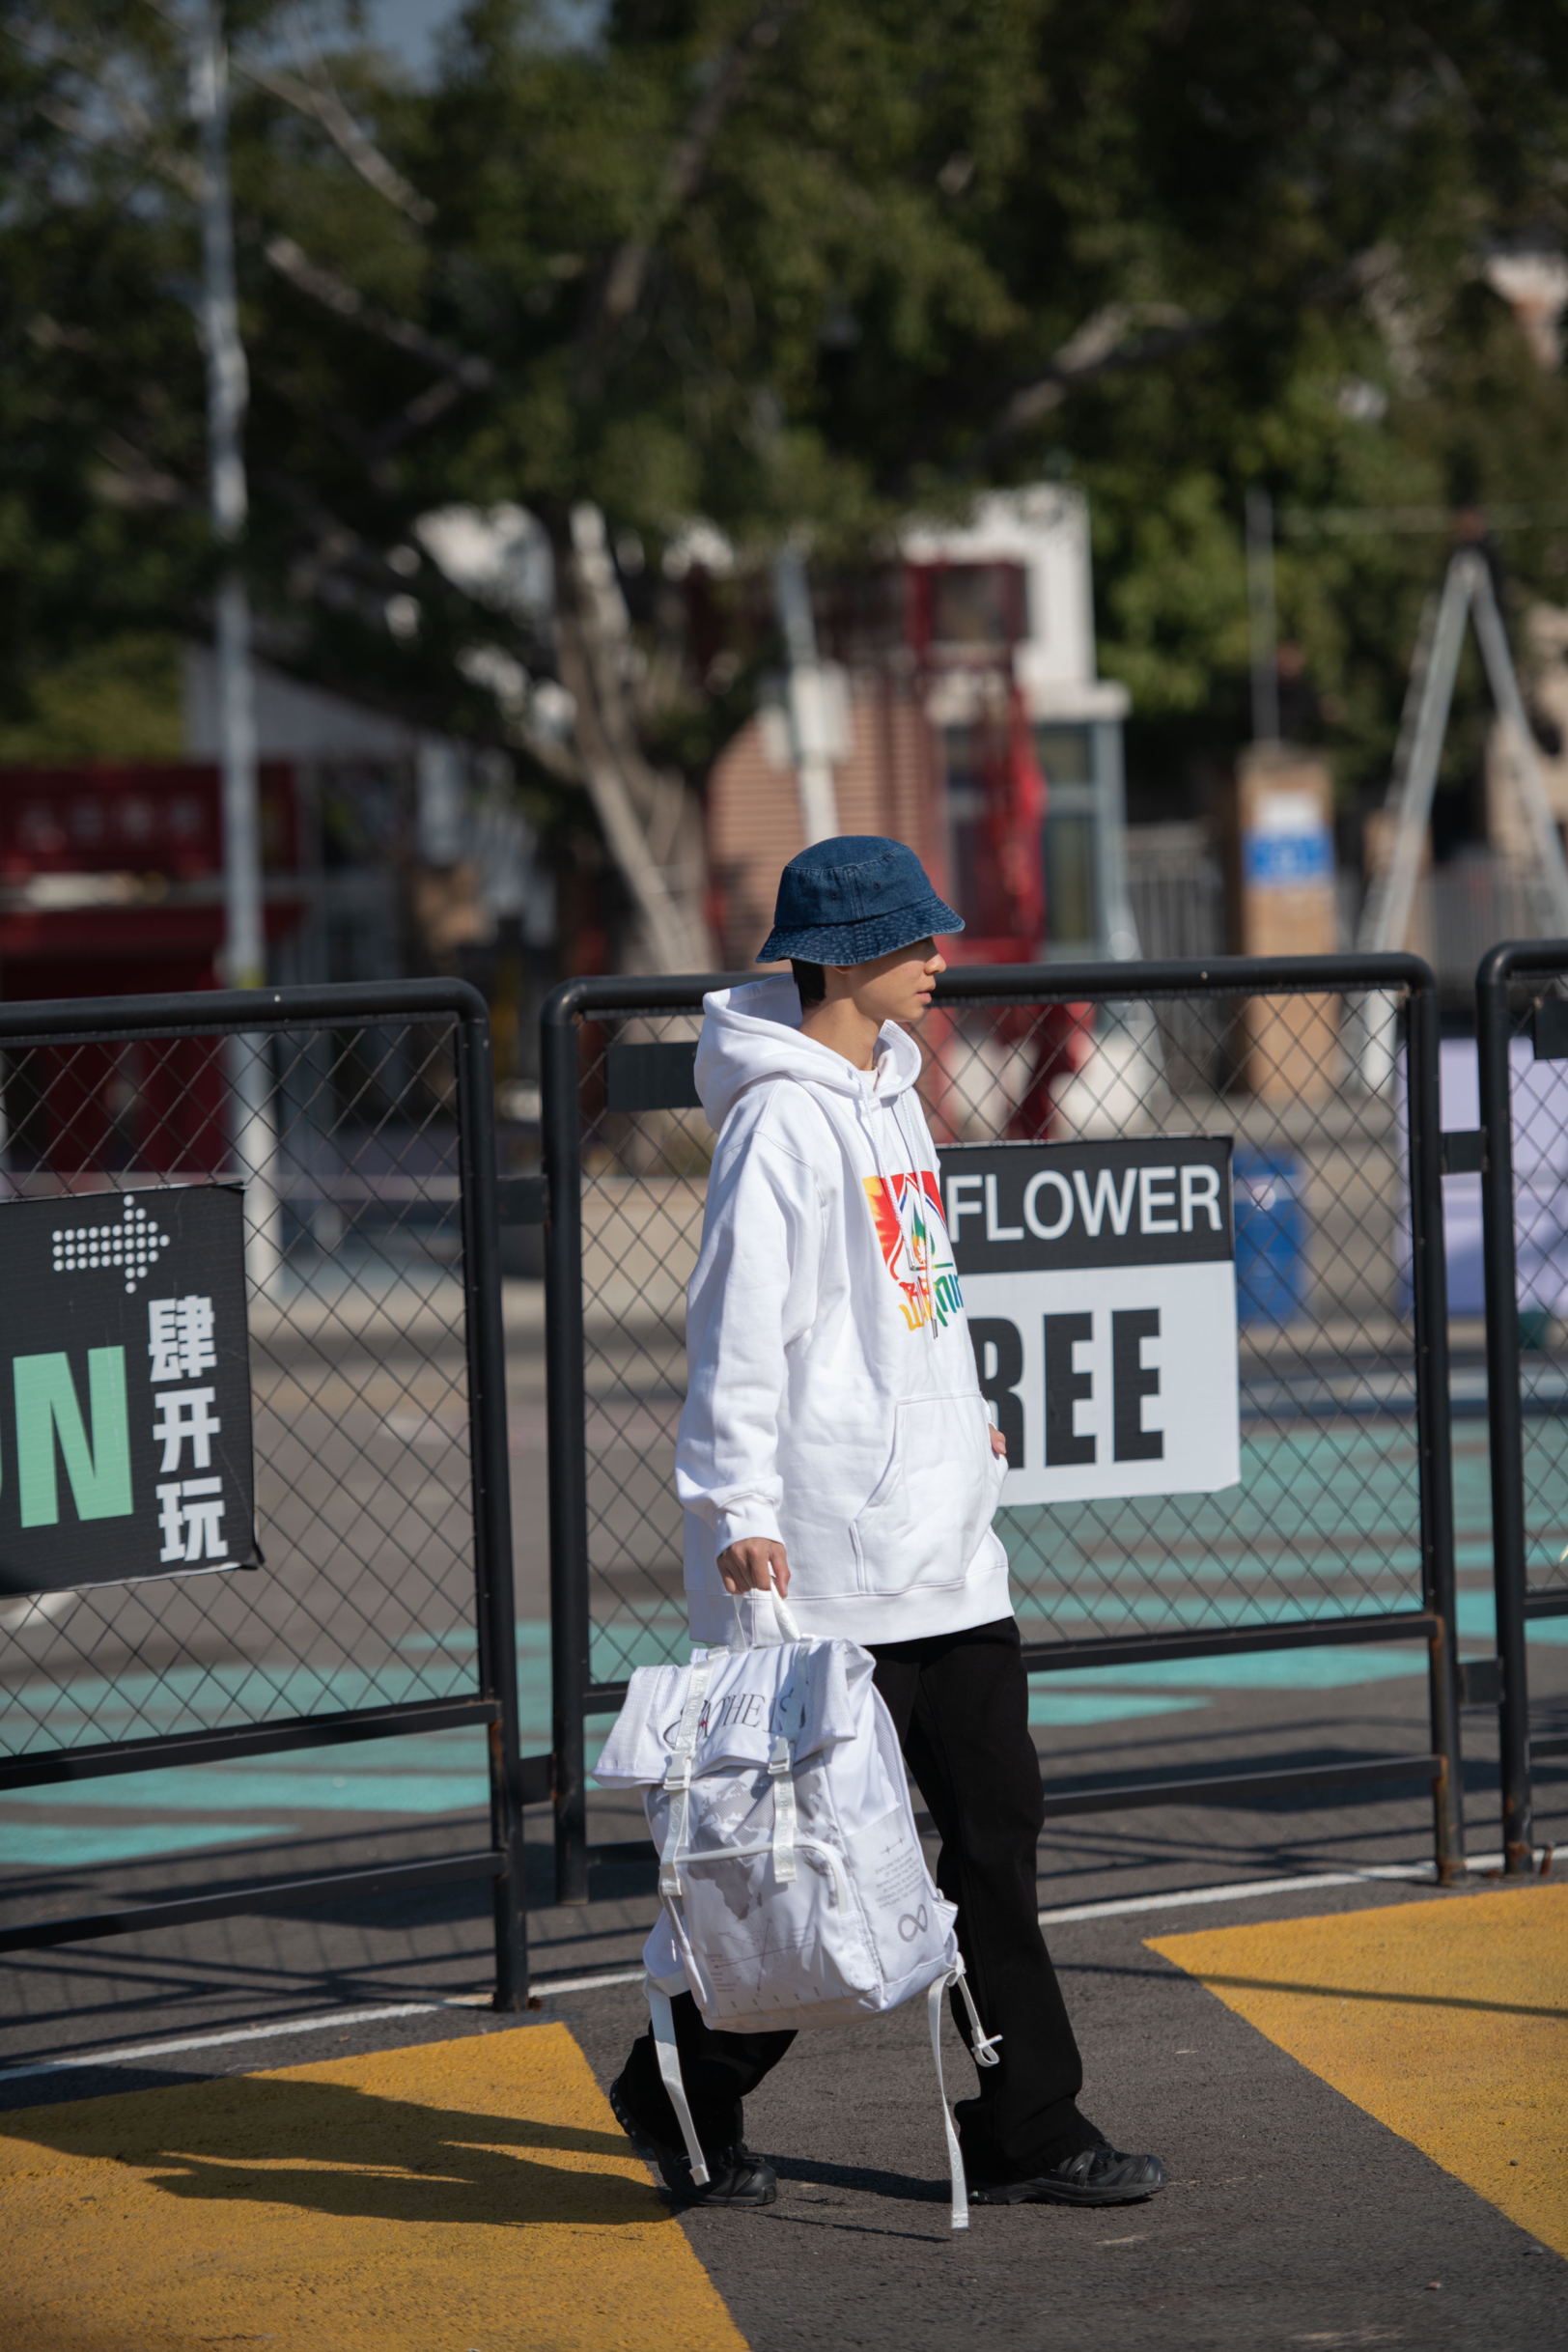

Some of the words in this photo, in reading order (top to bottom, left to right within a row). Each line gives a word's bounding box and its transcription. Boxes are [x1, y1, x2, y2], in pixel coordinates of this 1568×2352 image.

[946, 1164, 1223, 1244] FLOWER
[0, 1345, 134, 1528] N
[148, 1295, 229, 1563] 肆开玩
[967, 1307, 1164, 1470] REE
